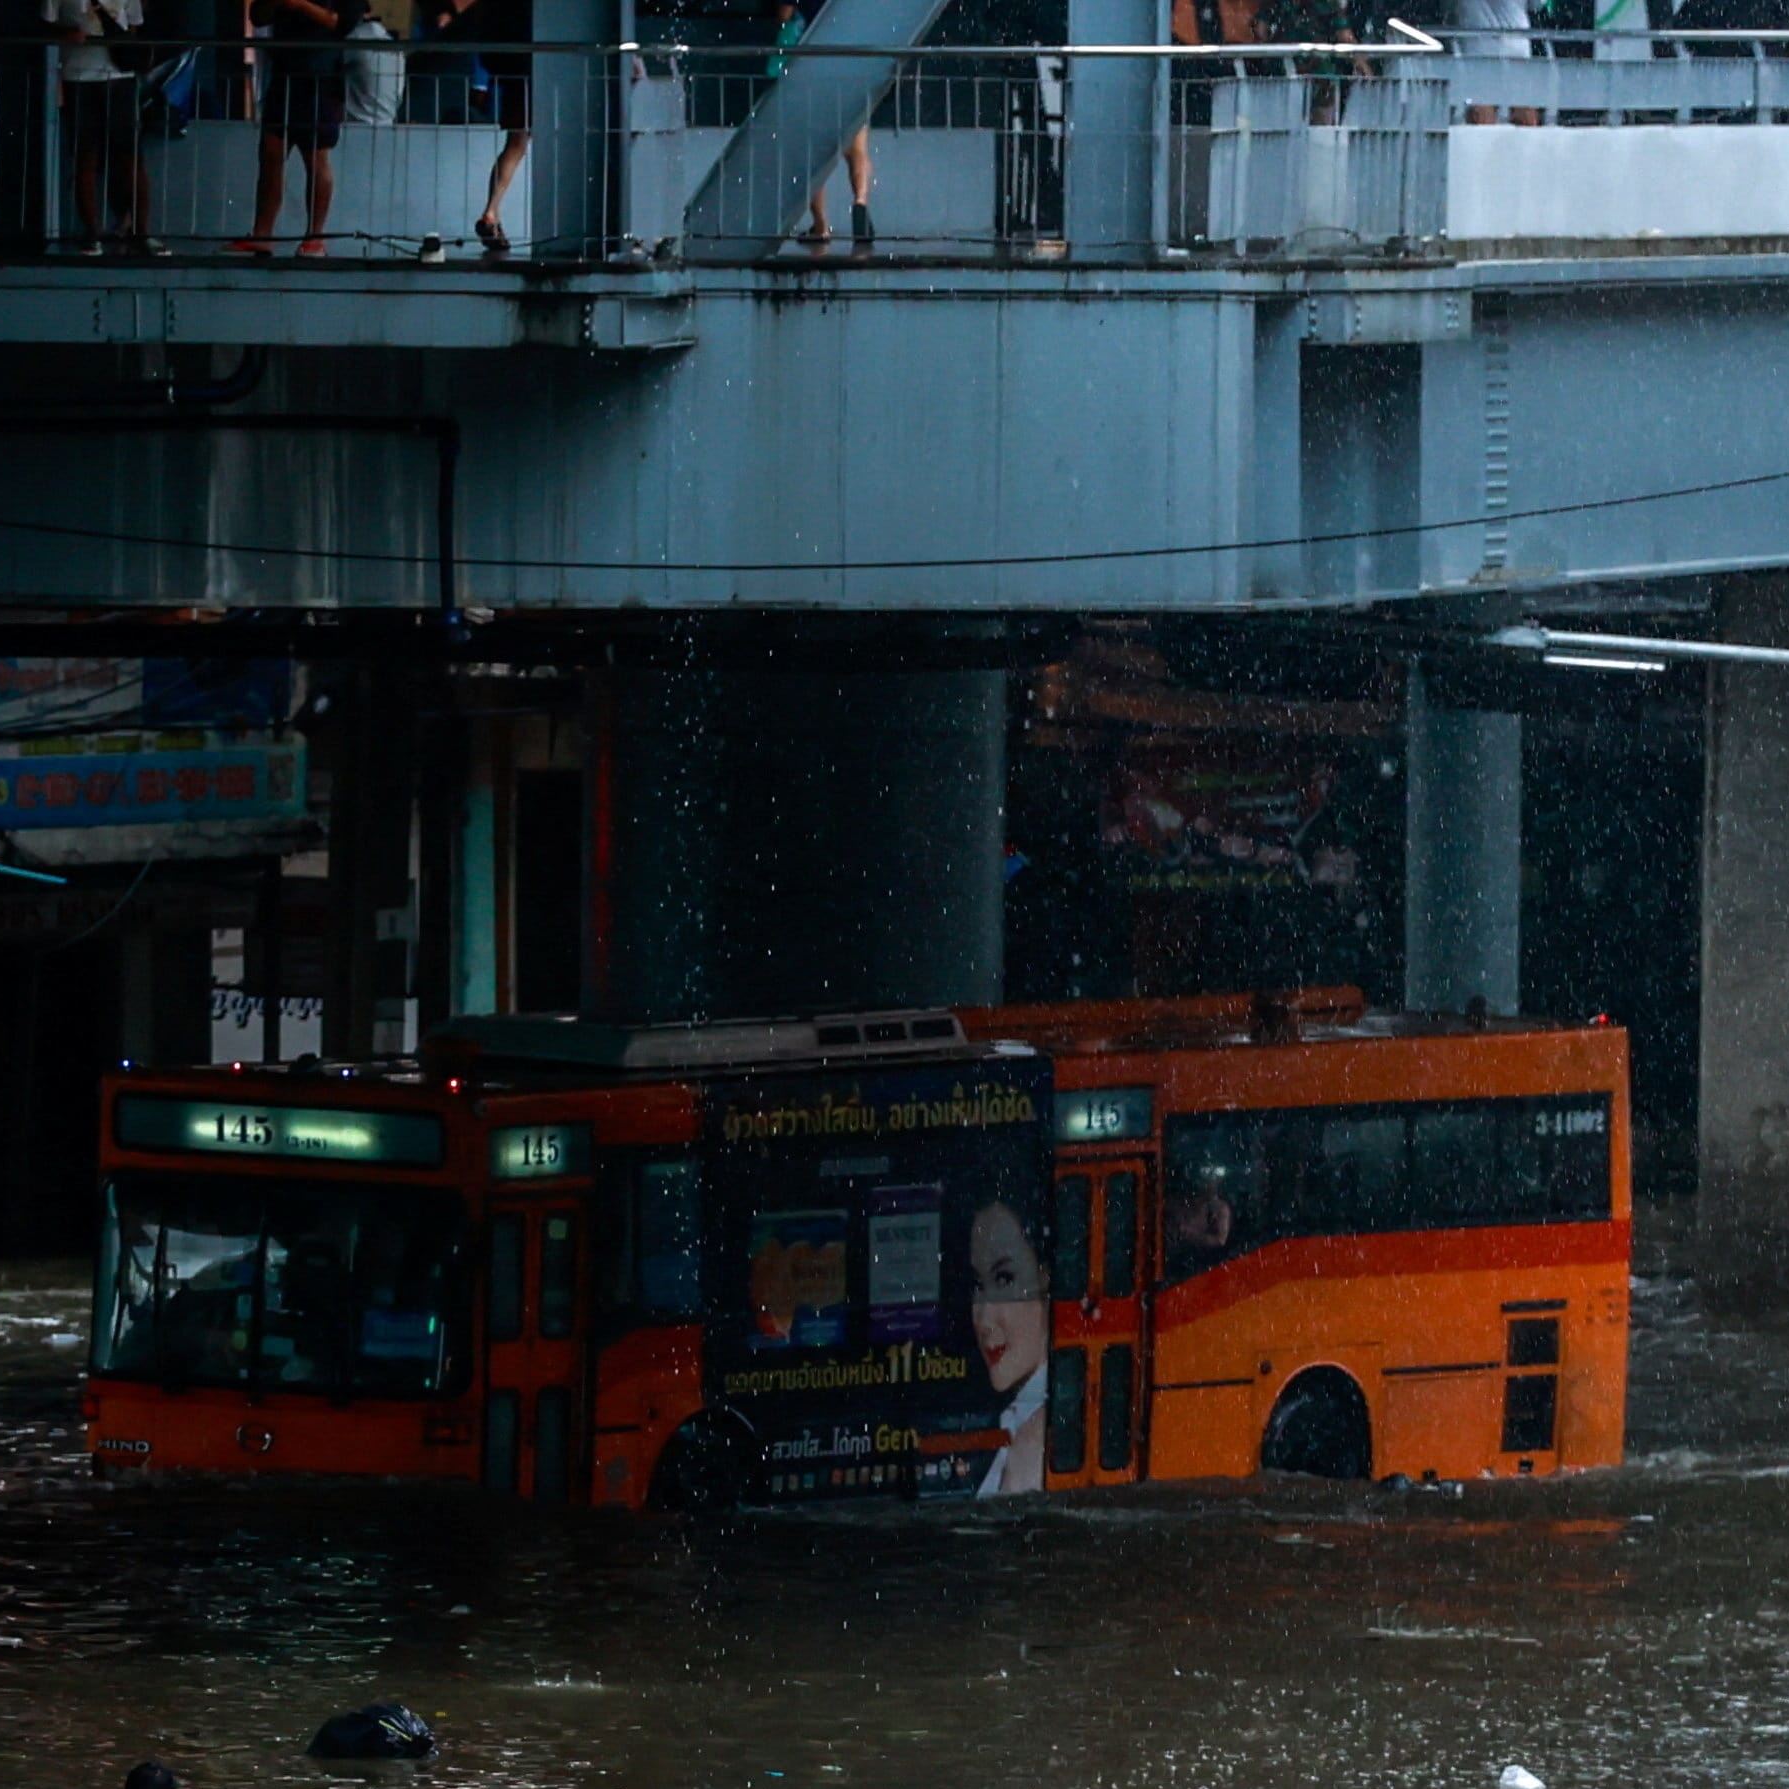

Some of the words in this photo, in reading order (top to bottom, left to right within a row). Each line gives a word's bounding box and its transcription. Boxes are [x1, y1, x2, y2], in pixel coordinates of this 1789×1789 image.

[214, 1112, 273, 1146] 145
[1087, 1099, 1120, 1130] 145
[523, 1134, 560, 1168] 145
[886, 1340, 915, 1384] 11
